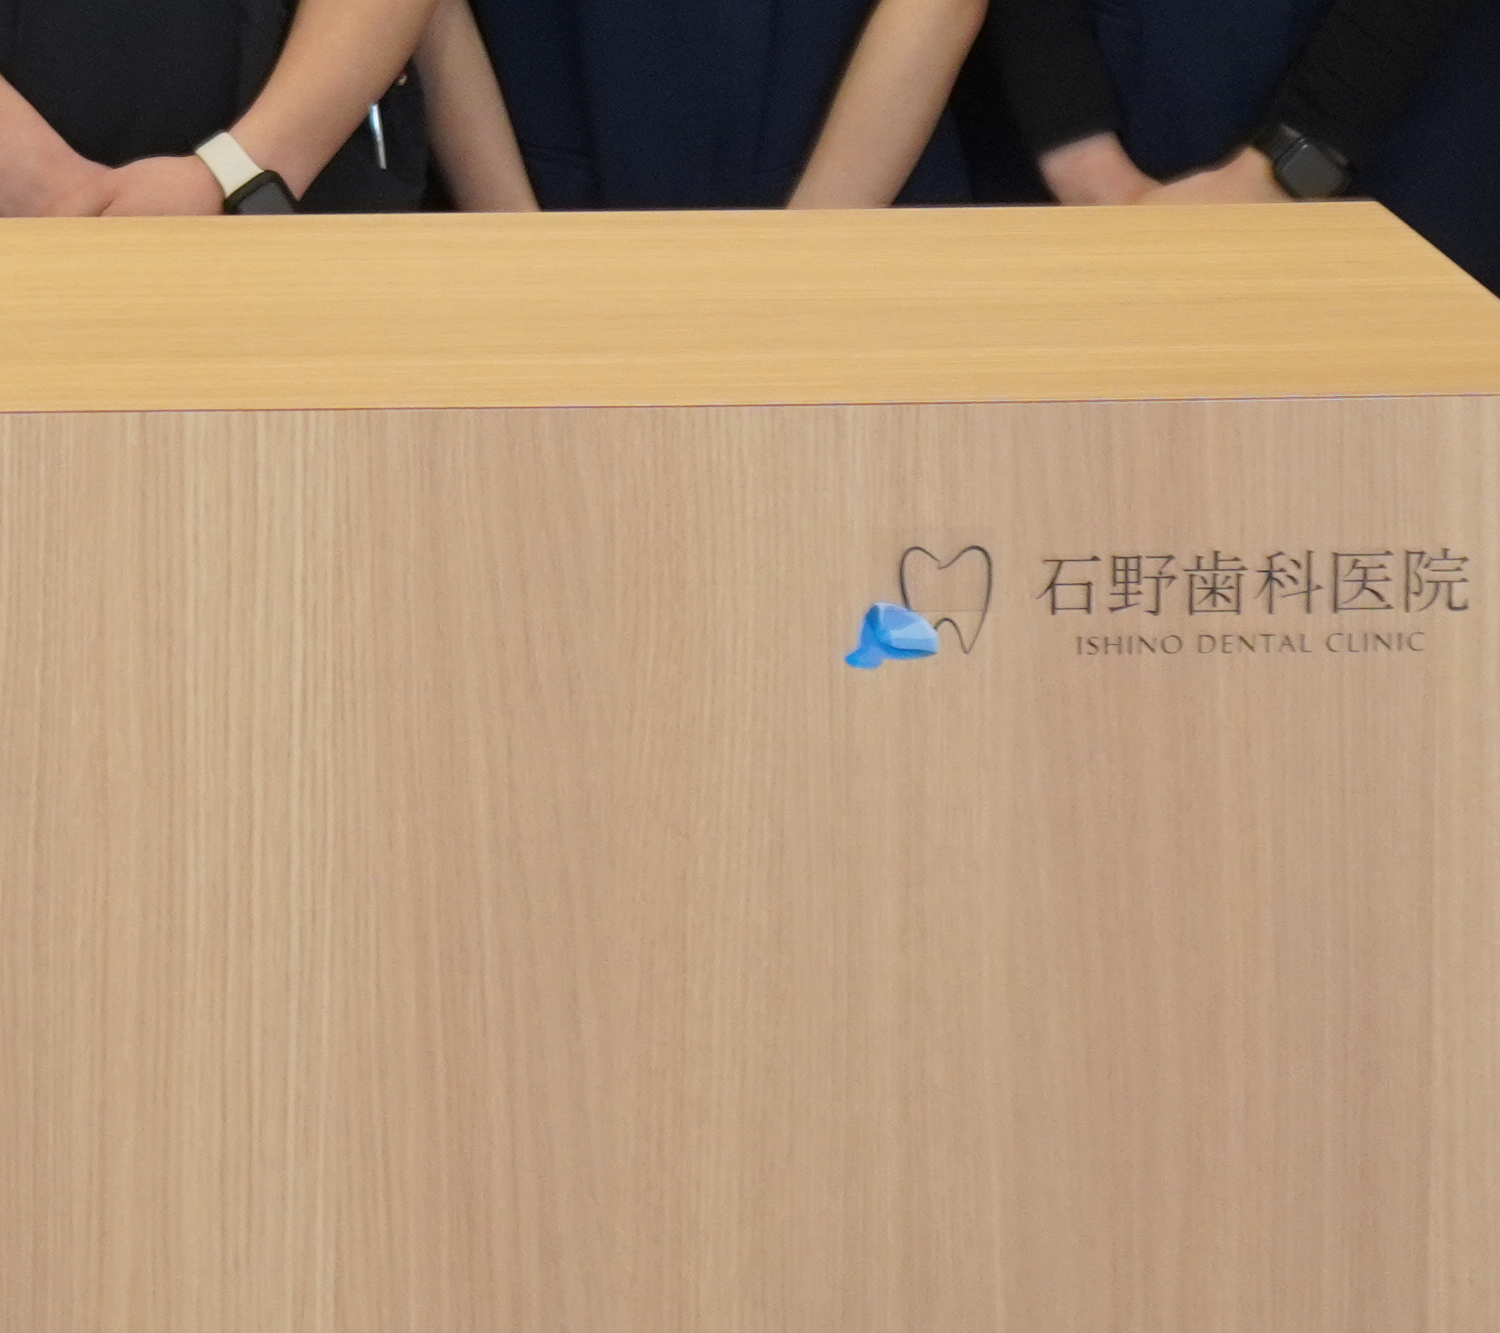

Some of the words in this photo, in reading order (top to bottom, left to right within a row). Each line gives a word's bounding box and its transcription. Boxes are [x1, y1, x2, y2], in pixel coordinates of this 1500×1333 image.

[1036, 547, 1470, 617] 石野歯科医院
[1076, 634, 1183, 656] ISHINO
[1197, 633, 1312, 655] DENTAL
[1325, 631, 1426, 653] CLINIC
